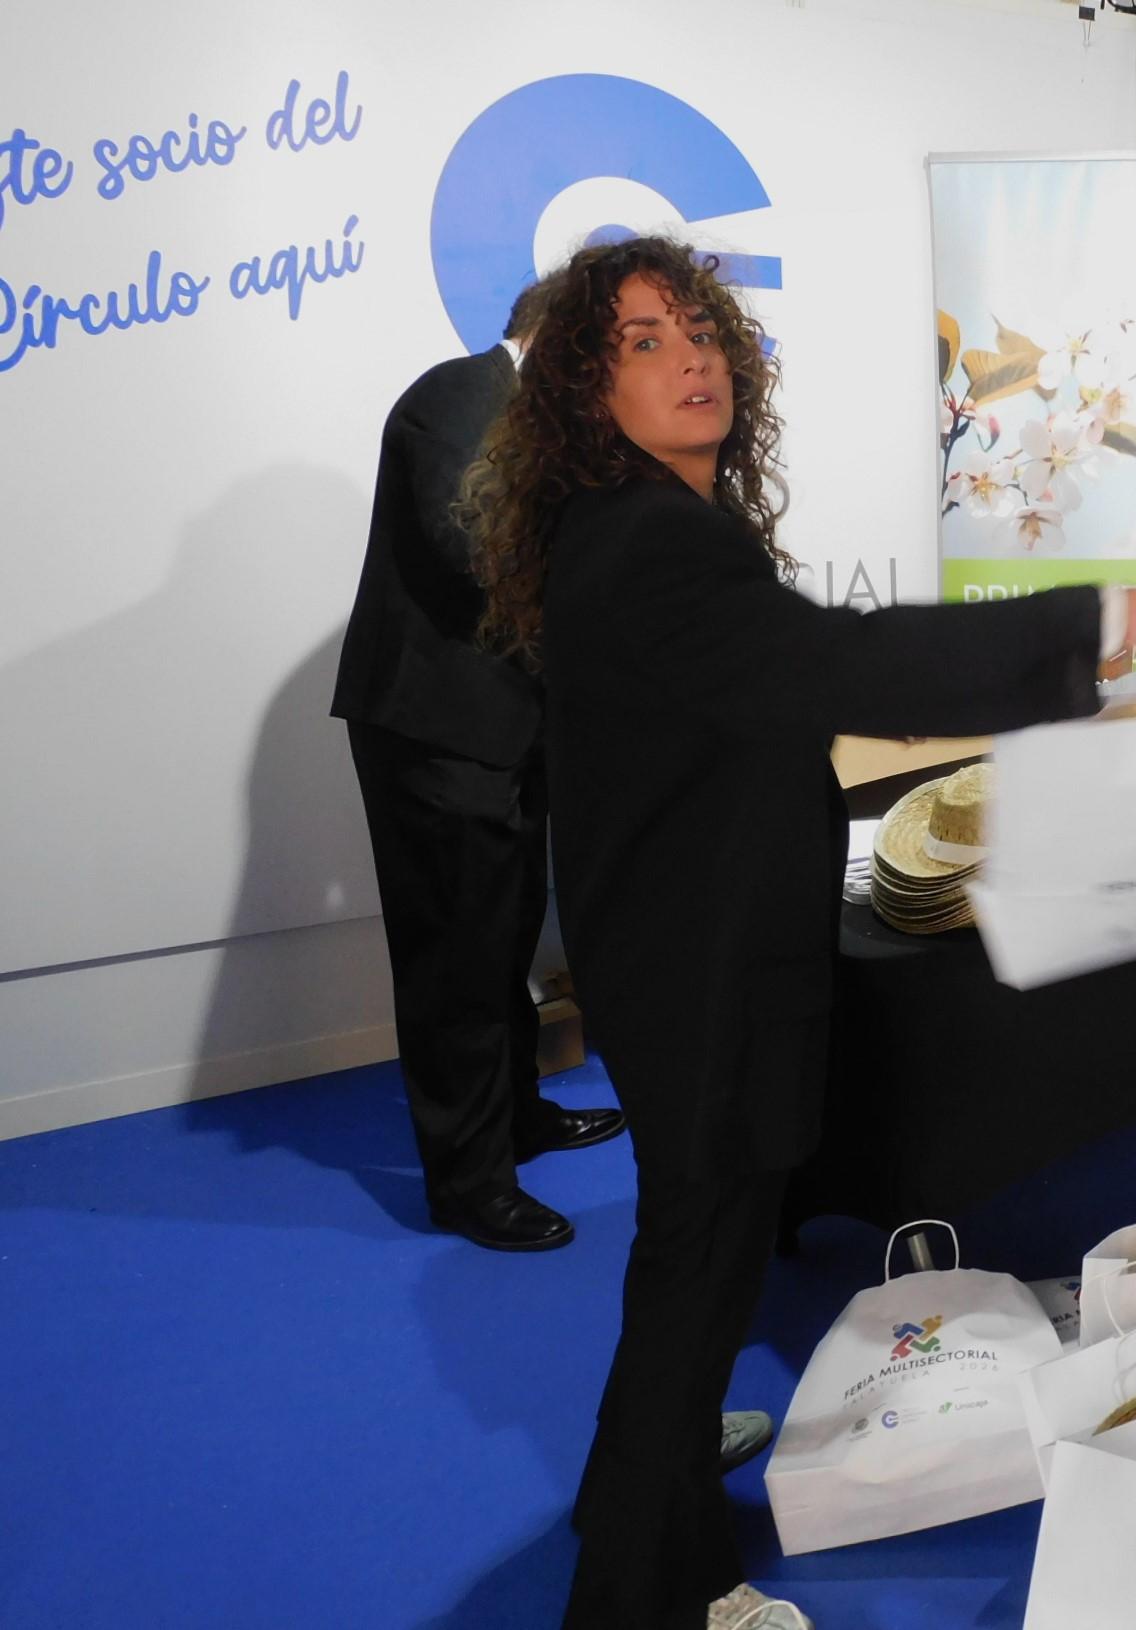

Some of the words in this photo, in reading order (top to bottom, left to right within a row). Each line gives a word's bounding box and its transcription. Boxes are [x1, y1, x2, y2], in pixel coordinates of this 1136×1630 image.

[93, 112, 247, 200] socio
[266, 70, 363, 152] del
[229, 214, 365, 321] aquí
[844, 1375, 875, 1400] FERIA
[879, 1349, 999, 1378] MULTISECTORIAL
